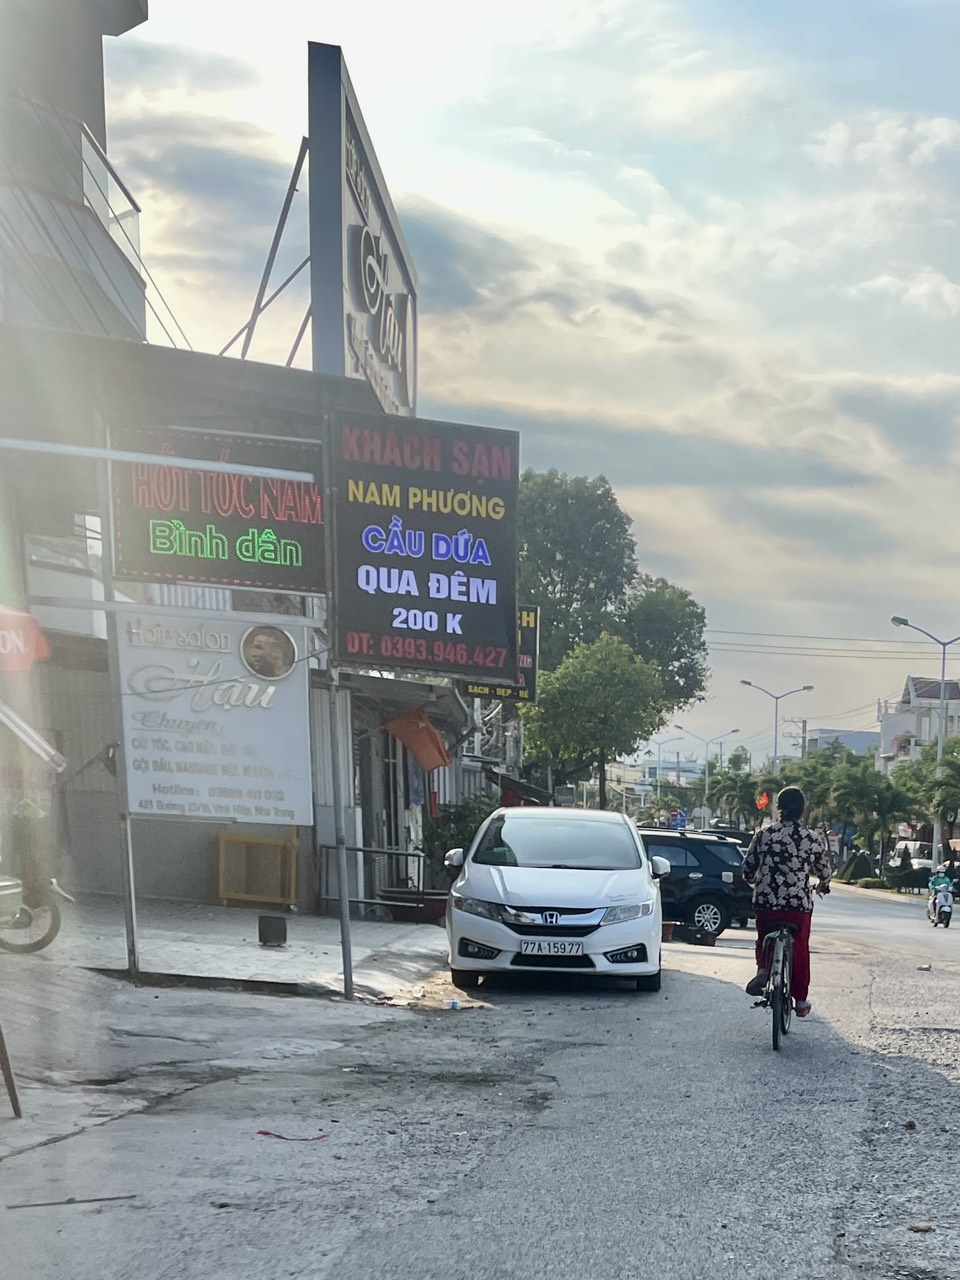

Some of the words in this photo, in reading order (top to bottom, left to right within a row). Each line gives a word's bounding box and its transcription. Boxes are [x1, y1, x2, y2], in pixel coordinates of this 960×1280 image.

[452, 439, 512, 485] SẠN
[348, 479, 401, 508] NAM
[408, 487, 506, 520] PHƯƠNG
[149, 519, 229, 560] Bình
[236, 528, 303, 567] dân
[362, 515, 425, 558] CẦU
[432, 528, 492, 566] DỨA
[357, 565, 420, 597] QUA
[428, 570, 497, 605] ĐÊM
[392, 607, 439, 632] 200
[446, 613, 463, 635] K
[380, 635, 508, 669] 0393.946.427
